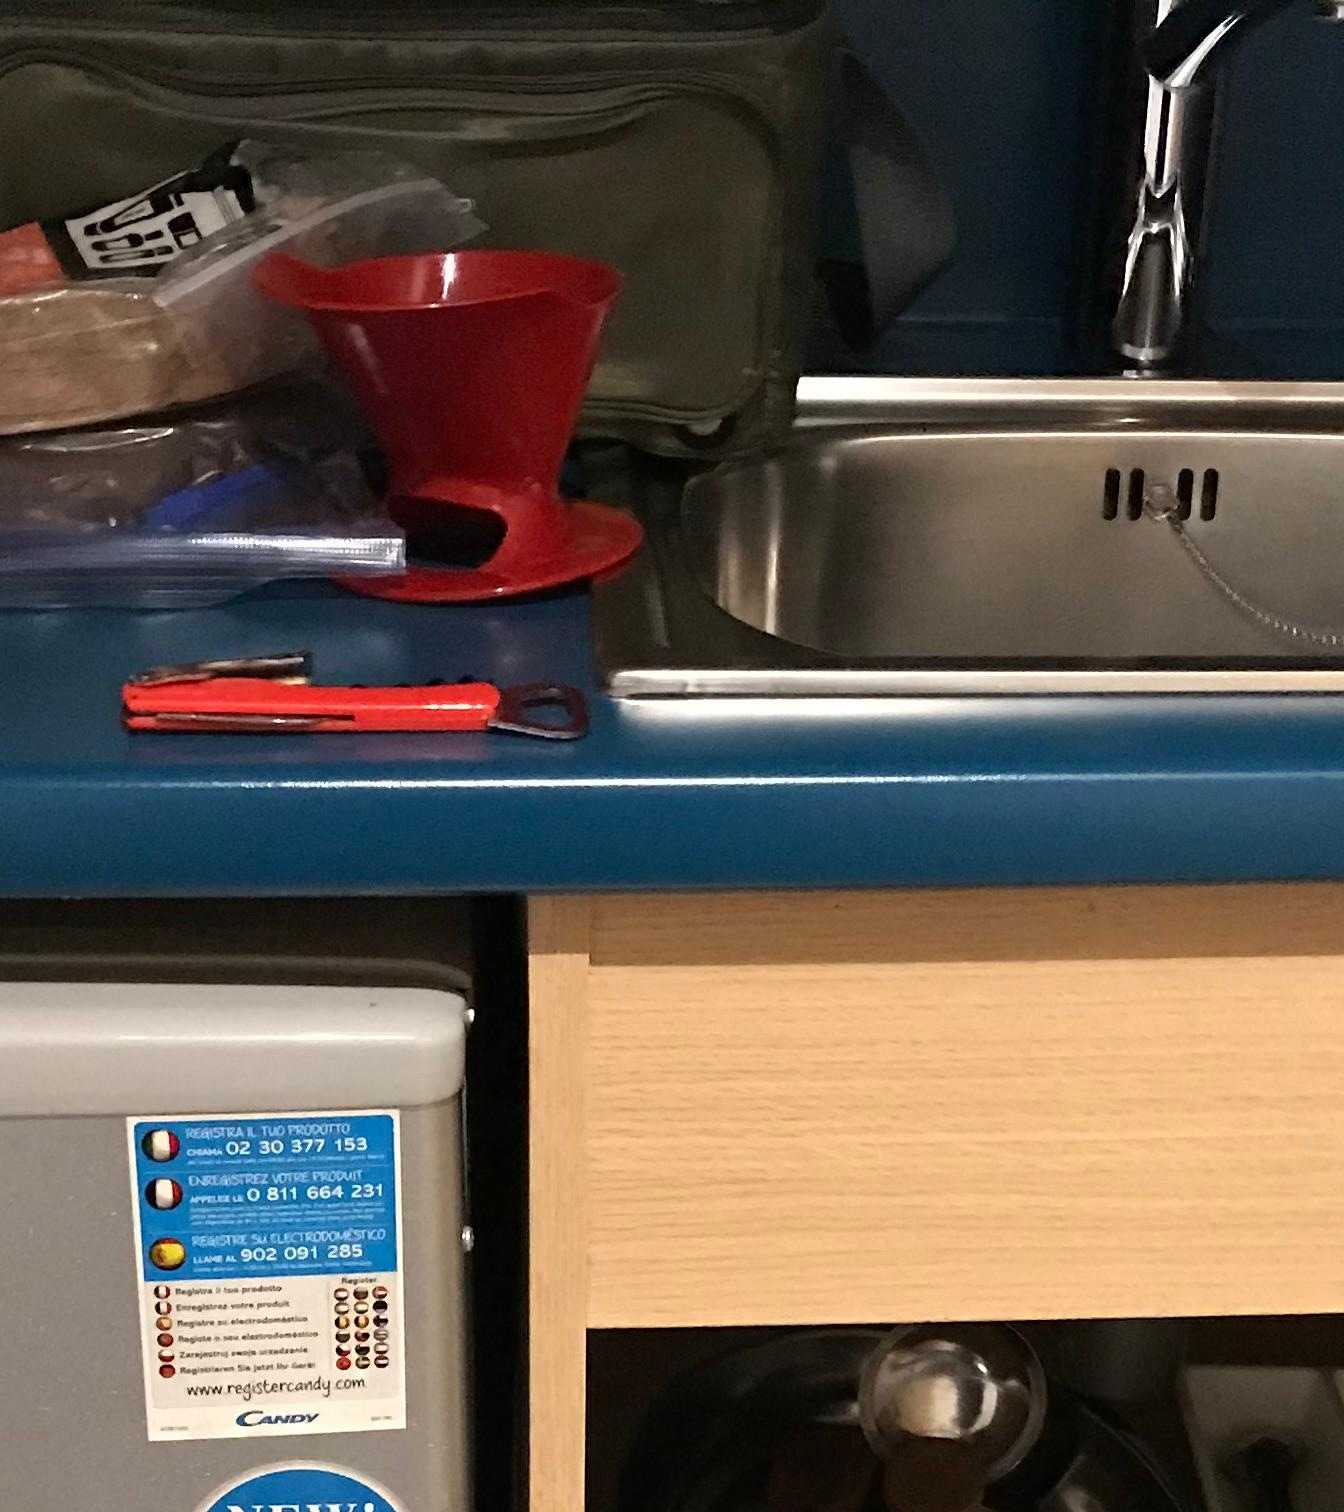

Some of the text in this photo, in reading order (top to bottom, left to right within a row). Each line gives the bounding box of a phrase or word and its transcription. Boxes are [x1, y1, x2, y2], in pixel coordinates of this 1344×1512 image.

[288, 1123, 351, 1136] PRODOTTO
[226, 1141, 251, 1156] 02
[259, 1140, 284, 1154] 30
[291, 1139, 325, 1153] 377
[334, 1137, 368, 1152] 153
[246, 1188, 260, 1202] 0
[267, 1186, 297, 1201] 811
[306, 1185, 344, 1200] 664
[351, 1183, 383, 1198] 231
[240, 1247, 277, 1262] 902
[284, 1246, 318, 1260] 091
[327, 1244, 363, 1259] 285
[186, 1376, 366, 1401] www.registercandy.com
